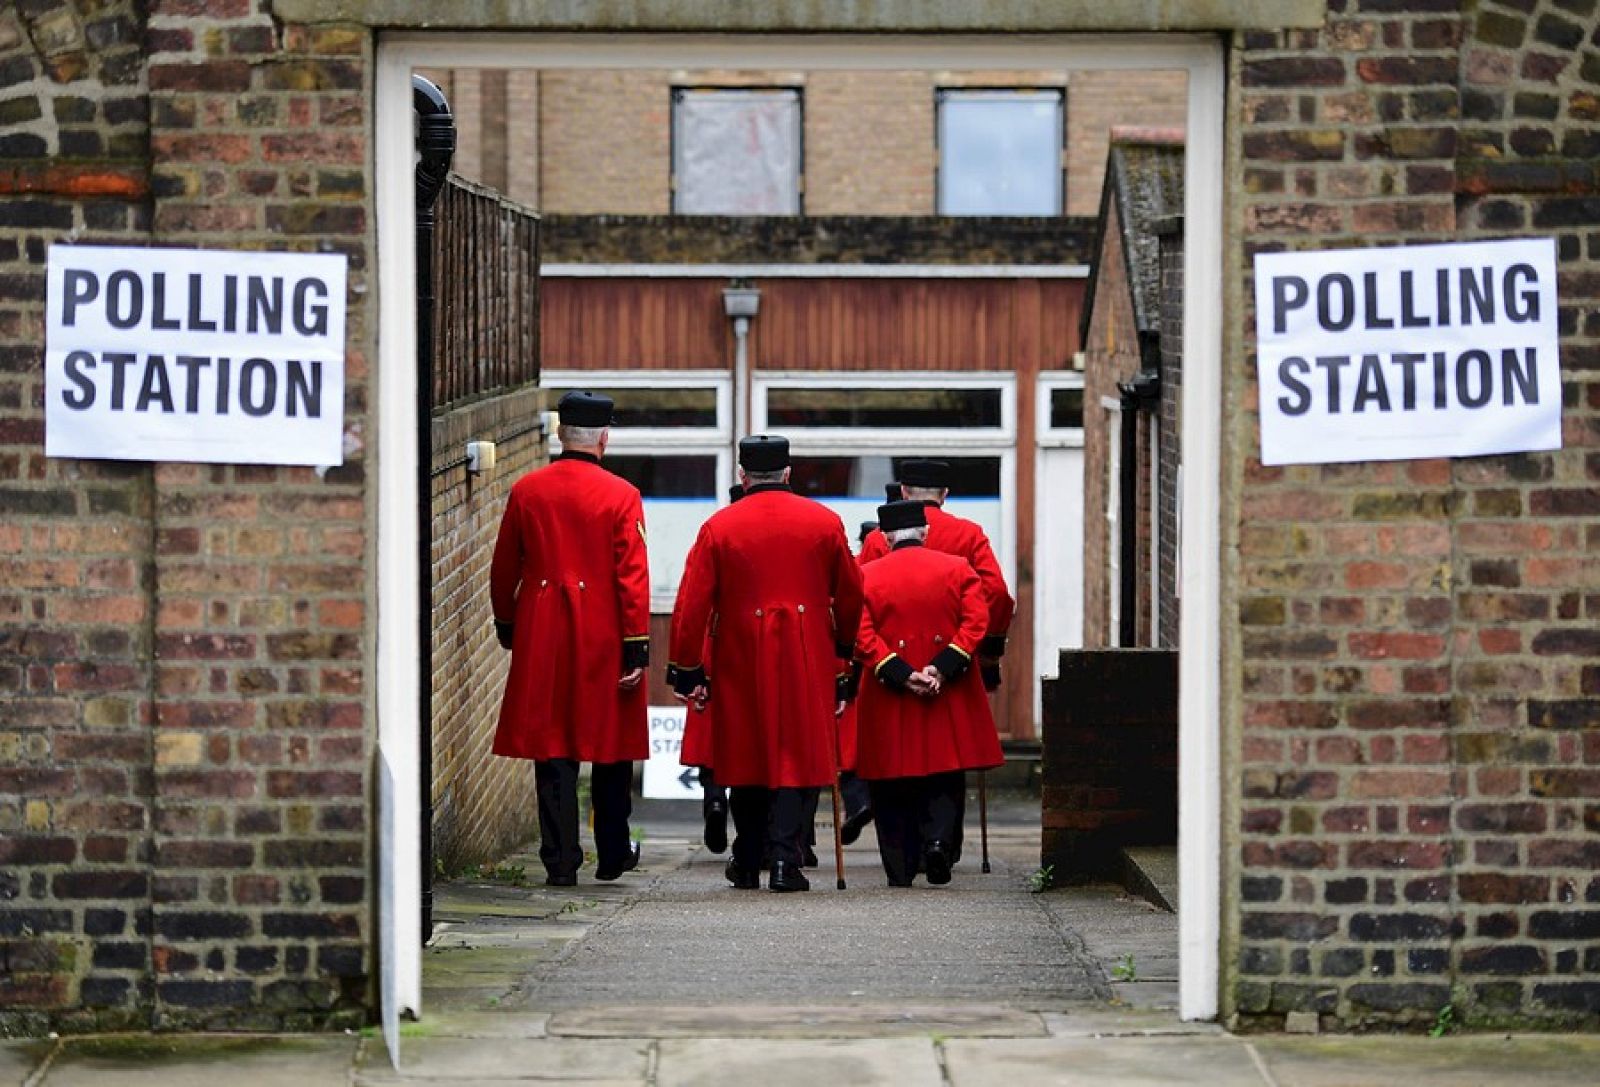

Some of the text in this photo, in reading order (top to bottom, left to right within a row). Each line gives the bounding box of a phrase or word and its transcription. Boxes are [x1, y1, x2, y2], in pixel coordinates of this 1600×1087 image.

[62, 269, 328, 336] POLLING
[1272, 263, 1540, 333] POLLING
[62, 350, 322, 418] STATION
[1277, 347, 1539, 416] STATION
